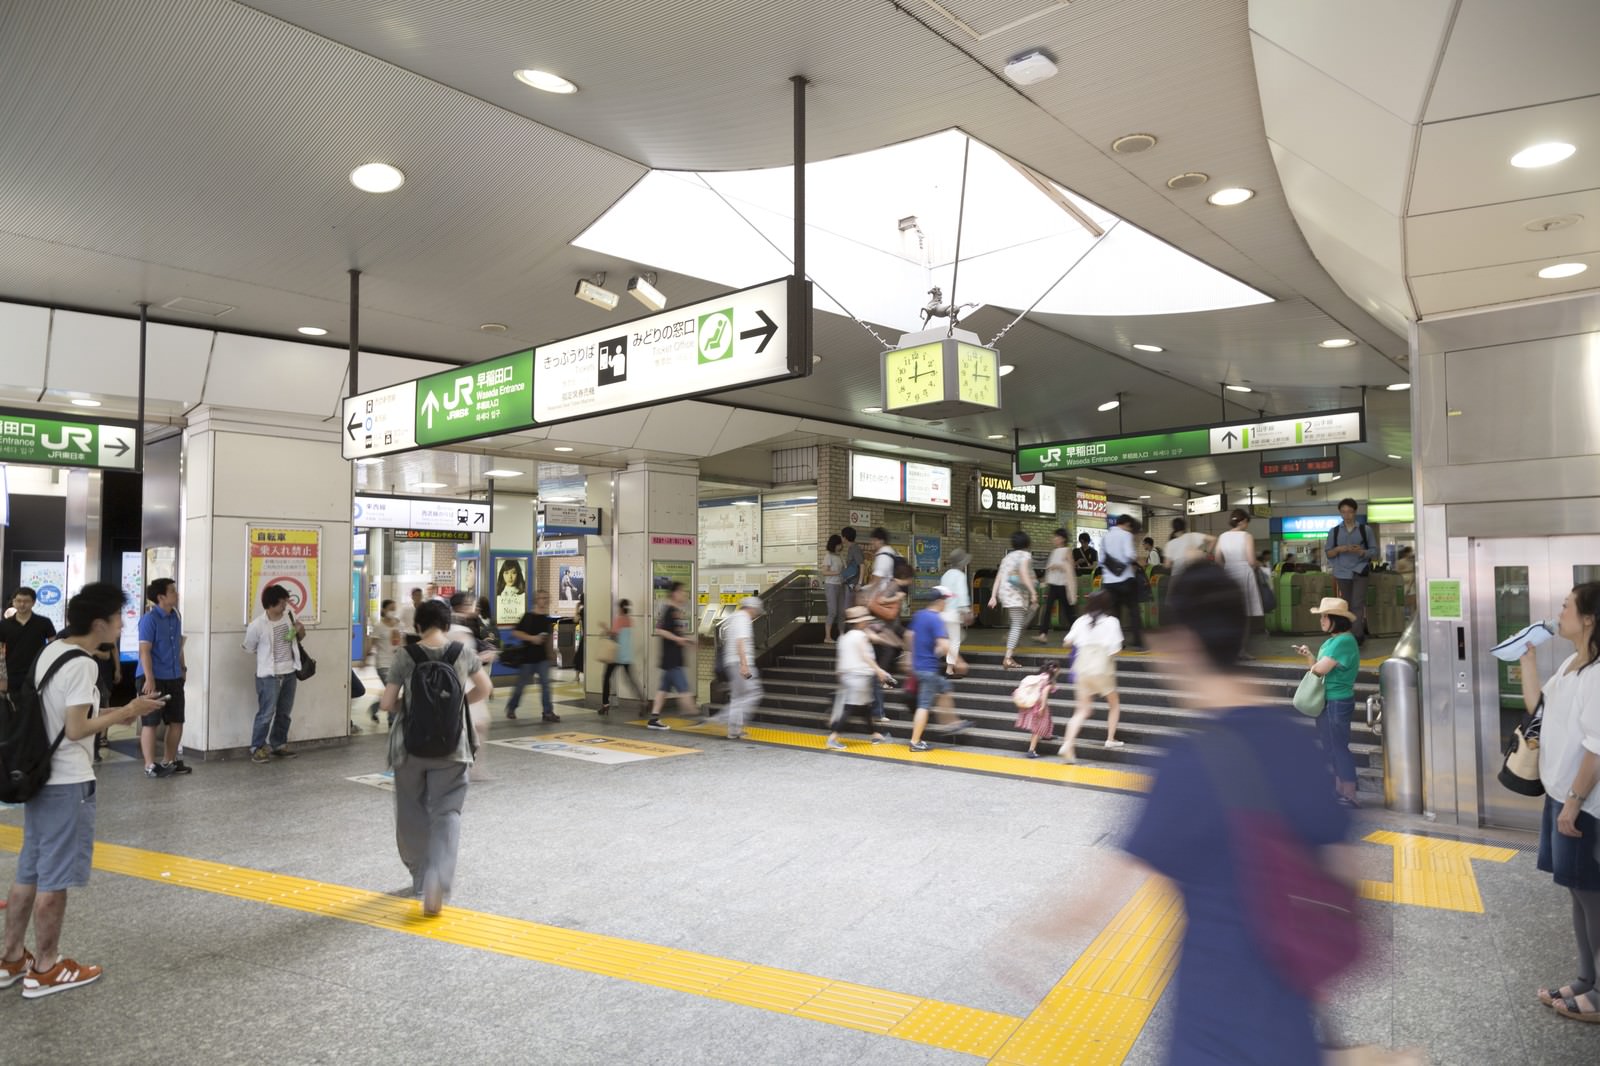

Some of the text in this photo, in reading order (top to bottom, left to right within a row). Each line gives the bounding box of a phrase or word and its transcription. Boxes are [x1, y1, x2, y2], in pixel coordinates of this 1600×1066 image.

[632, 318, 695, 347] みどりの窓口
[544, 343, 595, 370] きっぷうりば
[476, 365, 513, 389] 早稲田口
[443, 375, 474, 410] JR
[476, 382, 525, 401] Waseda Entrance
[0, 420, 36, 437] 田口
[1250, 427, 1256, 439] 1
[1303, 420, 1312, 433] 2
[41, 426, 92, 453] JR
[48, 452, 85, 461] JR東日本
[1040, 447, 1061, 463] JR
[1066, 443, 1106, 458] 早稲田口
[1066, 454, 1119, 466] Waseda Entrance
[981, 476, 1012, 490] TSUTAYA
[257, 532, 286, 541] 自転車
[260, 544, 312, 556] 乗入れ禁止
[503, 607, 518, 615] No.1
